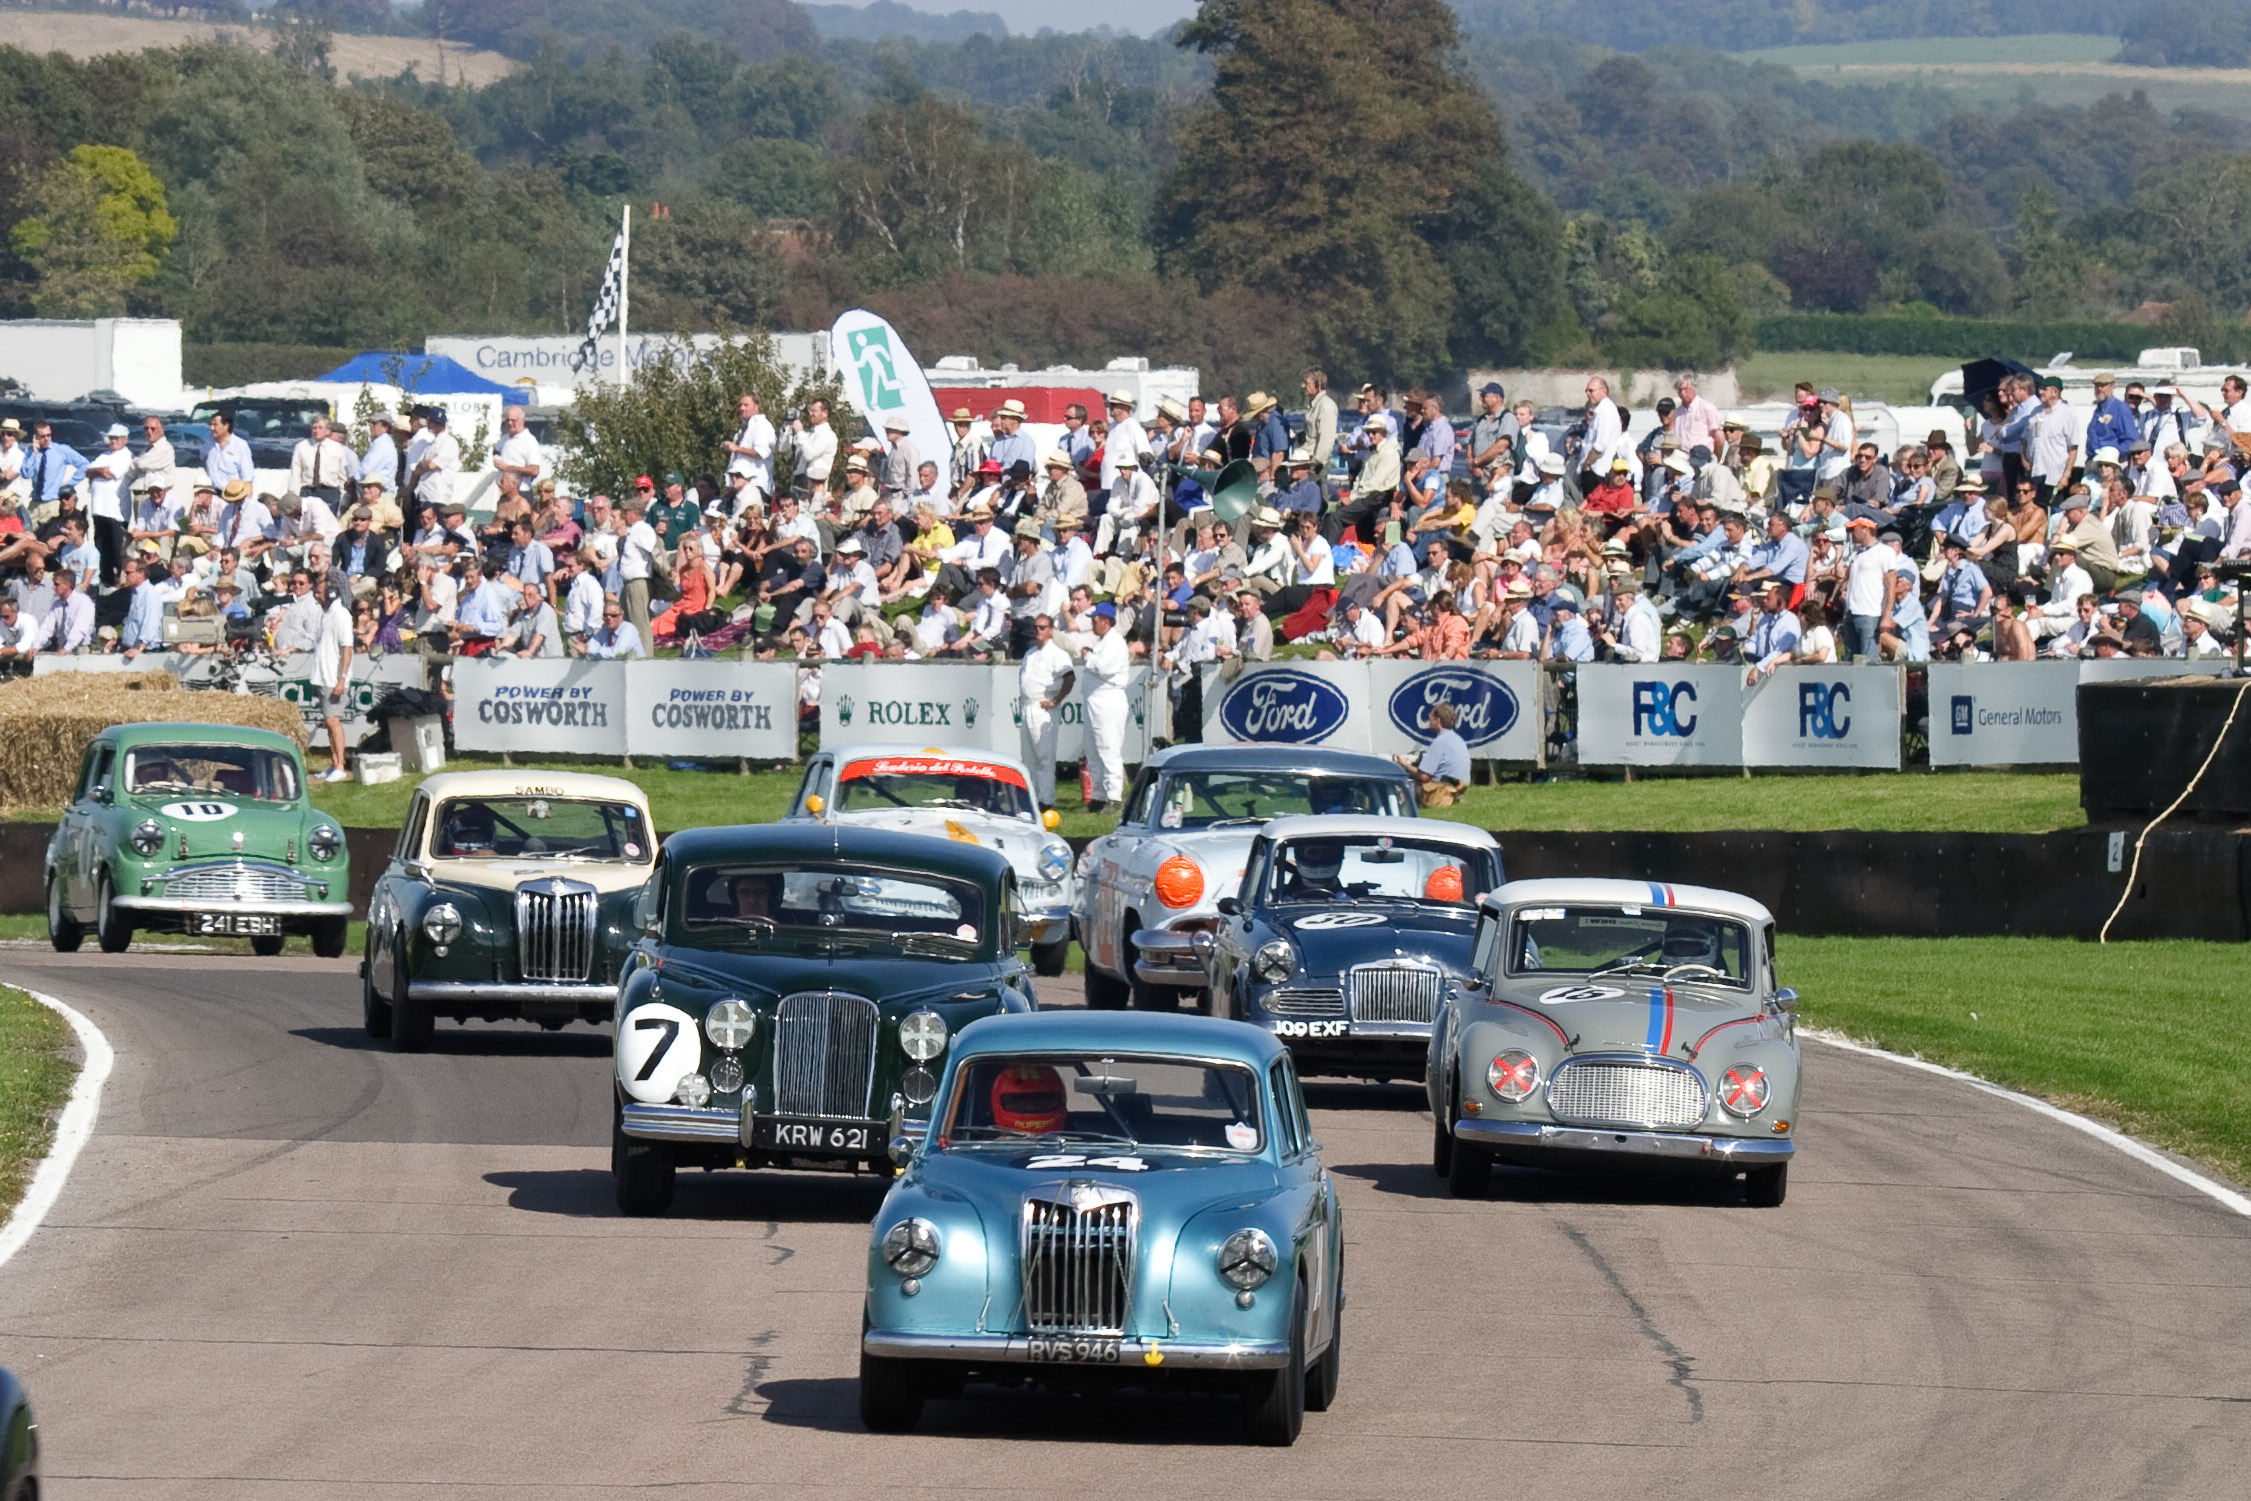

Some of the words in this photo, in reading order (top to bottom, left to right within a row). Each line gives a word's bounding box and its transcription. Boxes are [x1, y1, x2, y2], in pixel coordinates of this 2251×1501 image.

[495, 686, 564, 699] POWER
[569, 686, 593, 699] BY
[669, 688, 726, 702] POWER
[730, 689, 754, 703] BY
[1415, 678, 1492, 731] Frd
[478, 698, 607, 728] COSWORTH
[652, 702, 772, 730] COSWORTH
[868, 700, 951, 726] ROLEX
[1245, 681, 1317, 735] Ford
[1633, 680, 1697, 737] F&C
[1798, 681, 1851, 739] F&C
[1978, 707, 2022, 726] General
[2025, 706, 2062, 726] Motors
[515, 786, 565, 796] SAMBO
[181, 804, 224, 816] 10
[201, 914, 232, 932] 241
[634, 1018, 679, 1081] 7
[775, 1123, 823, 1146] KRW
[830, 1127, 868, 1149] 621
[1025, 1154, 1149, 1172] 24
[1030, 1340, 1073, 1362] RVS
[1075, 1342, 1118, 1362] 946
